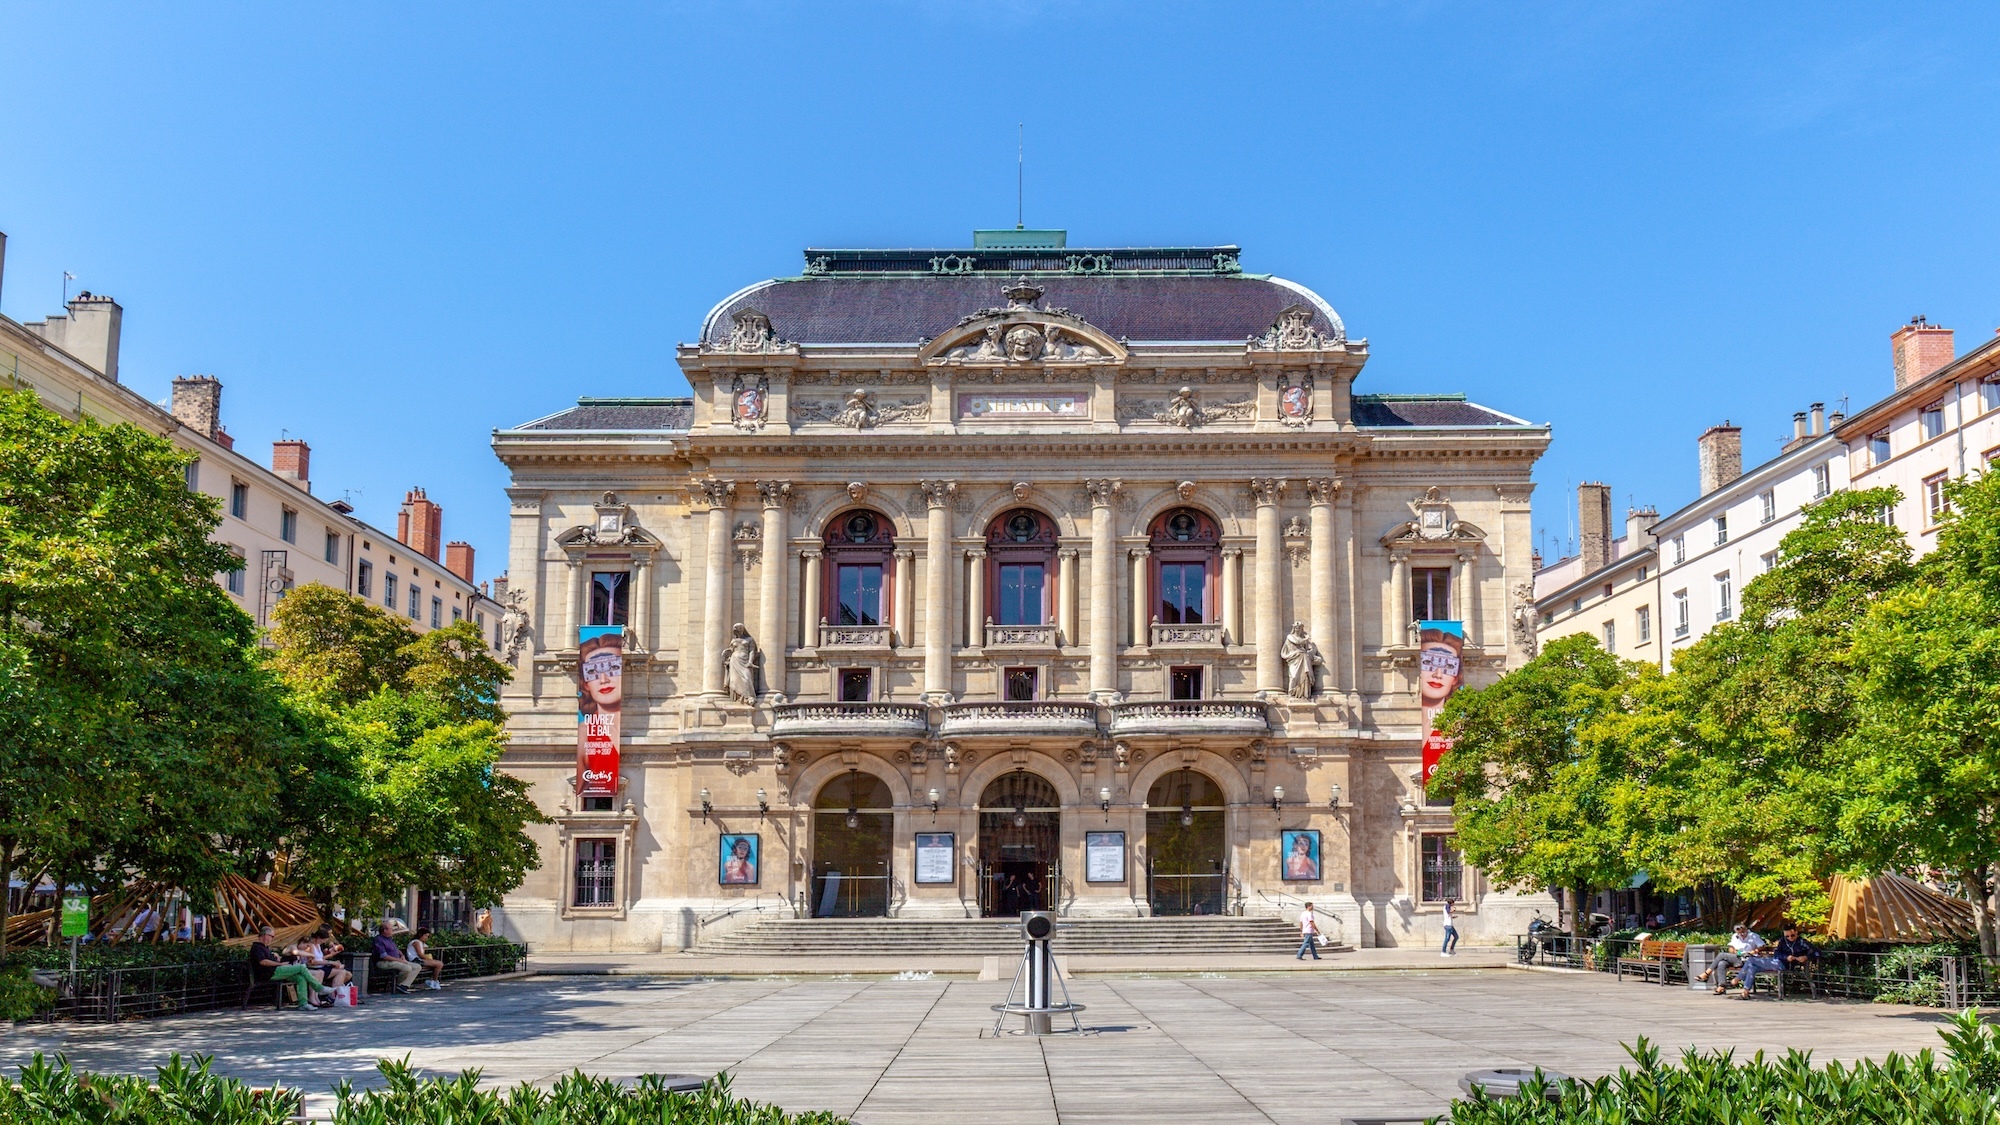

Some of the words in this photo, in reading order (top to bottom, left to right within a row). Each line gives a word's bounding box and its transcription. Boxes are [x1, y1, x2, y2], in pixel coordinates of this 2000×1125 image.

[584, 713, 614, 725] OUVREZ
[587, 725, 596, 736] LE
[597, 725, 611, 736] BAL
